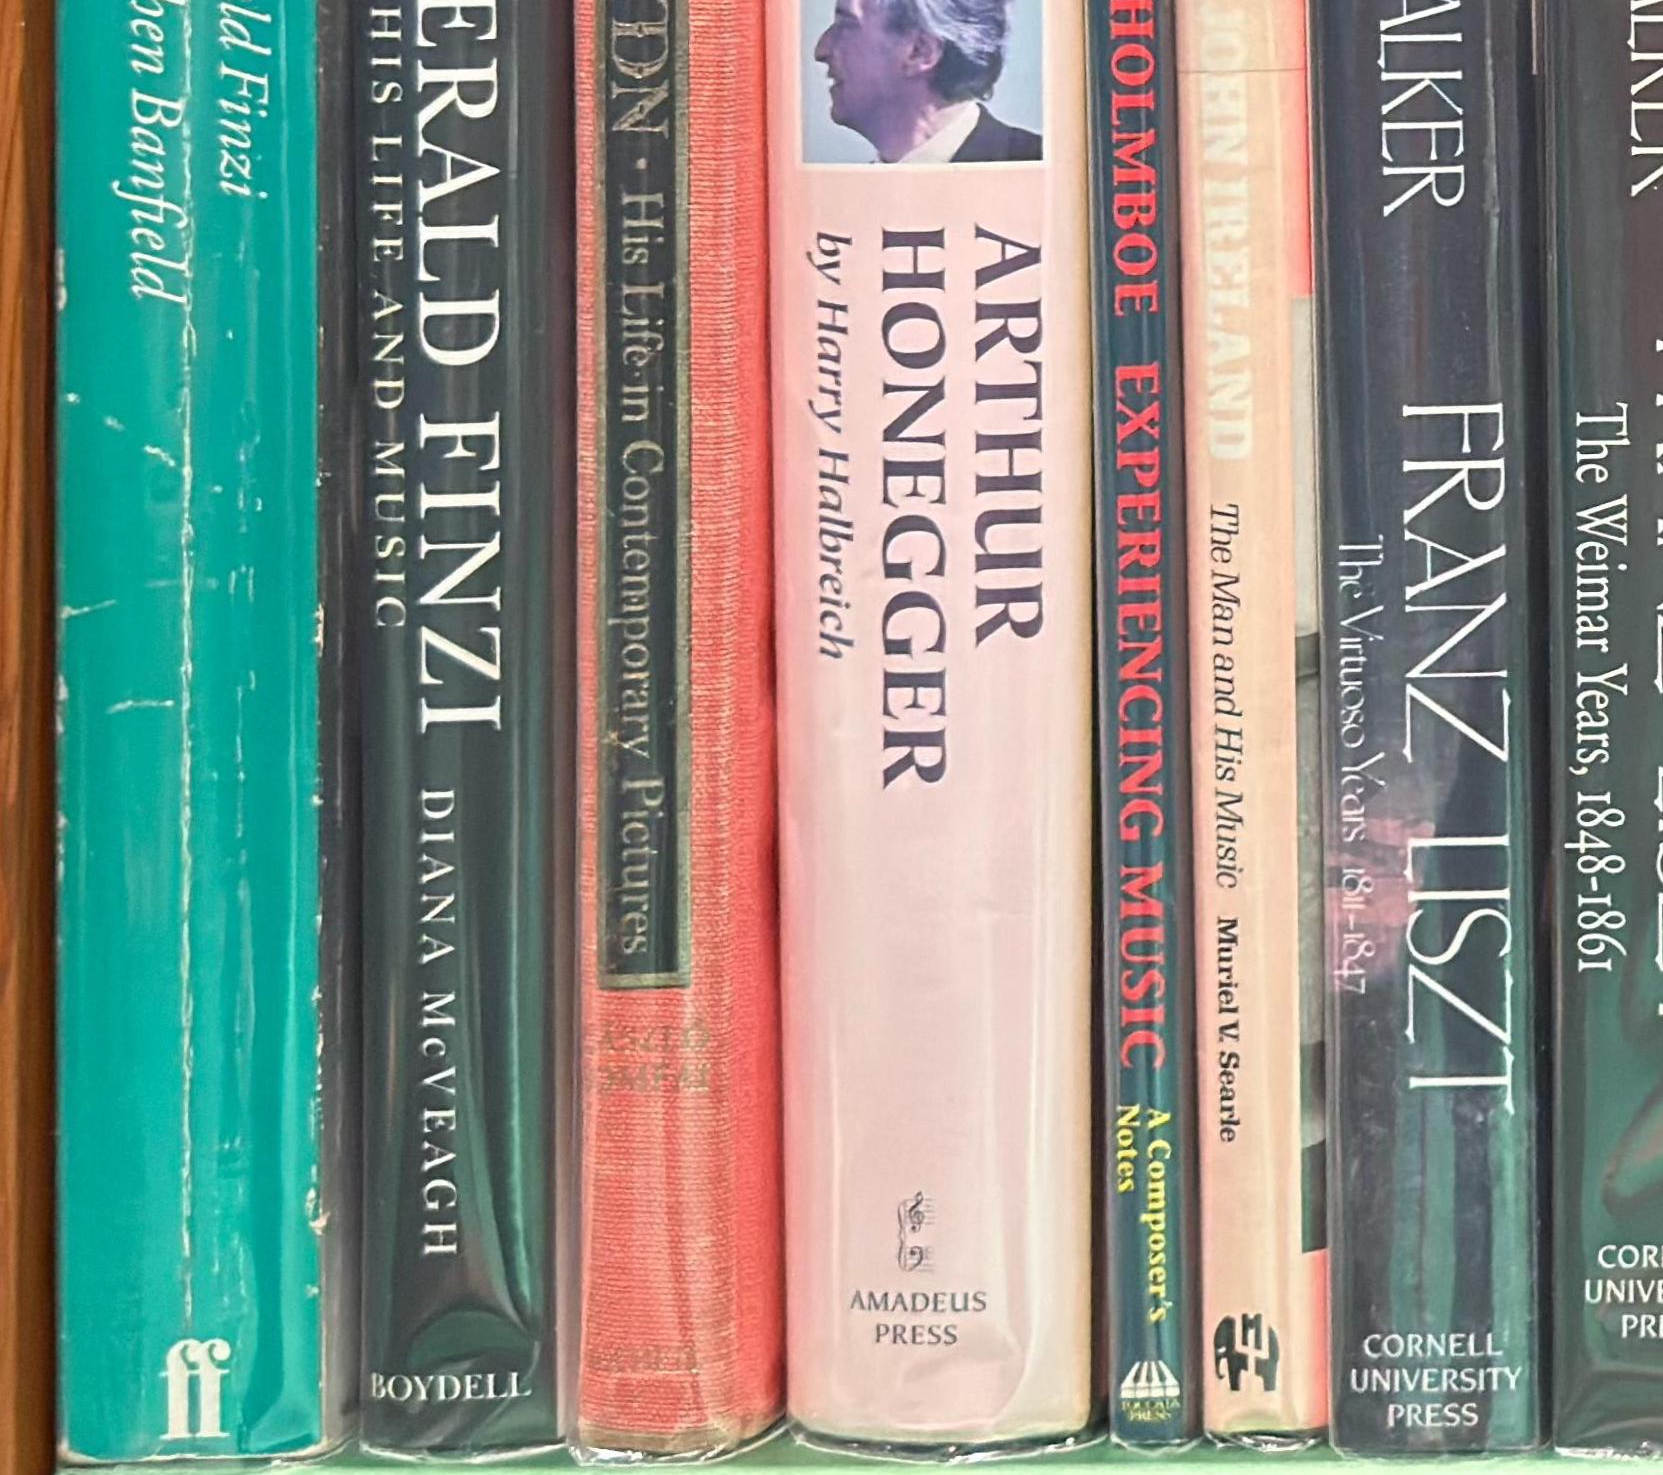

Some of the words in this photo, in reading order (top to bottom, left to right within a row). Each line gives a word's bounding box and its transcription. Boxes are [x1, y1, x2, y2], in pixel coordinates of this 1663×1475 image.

[369, 7, 403, 104] HIS
[1200, 3, 1248, 164] JOHN
[215, 66, 271, 203] Finzi
[114, 92, 189, 307] Banfield
[369, 137, 404, 262] LIFE
[621, 191, 665, 265] His
[805, 230, 854, 290] by
[370, 291, 406, 410] AND
[621, 283, 665, 363] Life
[812, 294, 852, 431] Harry
[1203, 171, 1254, 460] IRELAND
[623, 376, 665, 423] in
[971, 222, 1044, 650] ARTHUR
[1575, 402, 1631, 483] The
[370, 442, 406, 628] MUSIC
[815, 452, 854, 660] Halbreich
[881, 227, 949, 791] HONEGGER
[1209, 504, 1239, 564] The
[416, 410, 505, 731] FINZI
[606, 440, 667, 760] Contemporary
[1114, 362, 1166, 840] EXPERIENCING
[1210, 574, 1242, 645] Man
[1338, 534, 1384, 599] The
[1400, 401, 1511, 763] FRANZ
[1575, 494, 1629, 653] Weimar
[1213, 652, 1243, 716] and
[1338, 606, 1384, 749] Virtuoso
[1568, 664, 1629, 776] Years,
[1215, 725, 1243, 781] His
[1340, 751, 1387, 843] Years
[419, 788, 456, 964] DIANA
[621, 778, 664, 956] Pictures
[1214, 790, 1244, 888] Music
[1118, 863, 1165, 1071] MUSIC
[1217, 915, 1239, 1018] Muriel
[1401, 839, 1515, 1116] LISZT
[1218, 1019, 1239, 1042] V.
[420, 993, 459, 1256] McVEAGH
[1117, 1104, 1140, 1193] Notes
[1148, 1107, 1172, 1129] A
[1218, 1050, 1240, 1143] Searle
[1140, 1139, 1173, 1324] Composer's
[850, 1289, 988, 1313] AMADEUS
[874, 1320, 959, 1346] PRESS
[1362, 1332, 1504, 1358] CORNELL
[369, 1370, 532, 1402] BOYDELL
[1350, 1366, 1522, 1393] UNIVERSITY
[1387, 1401, 1479, 1428] PRESS
